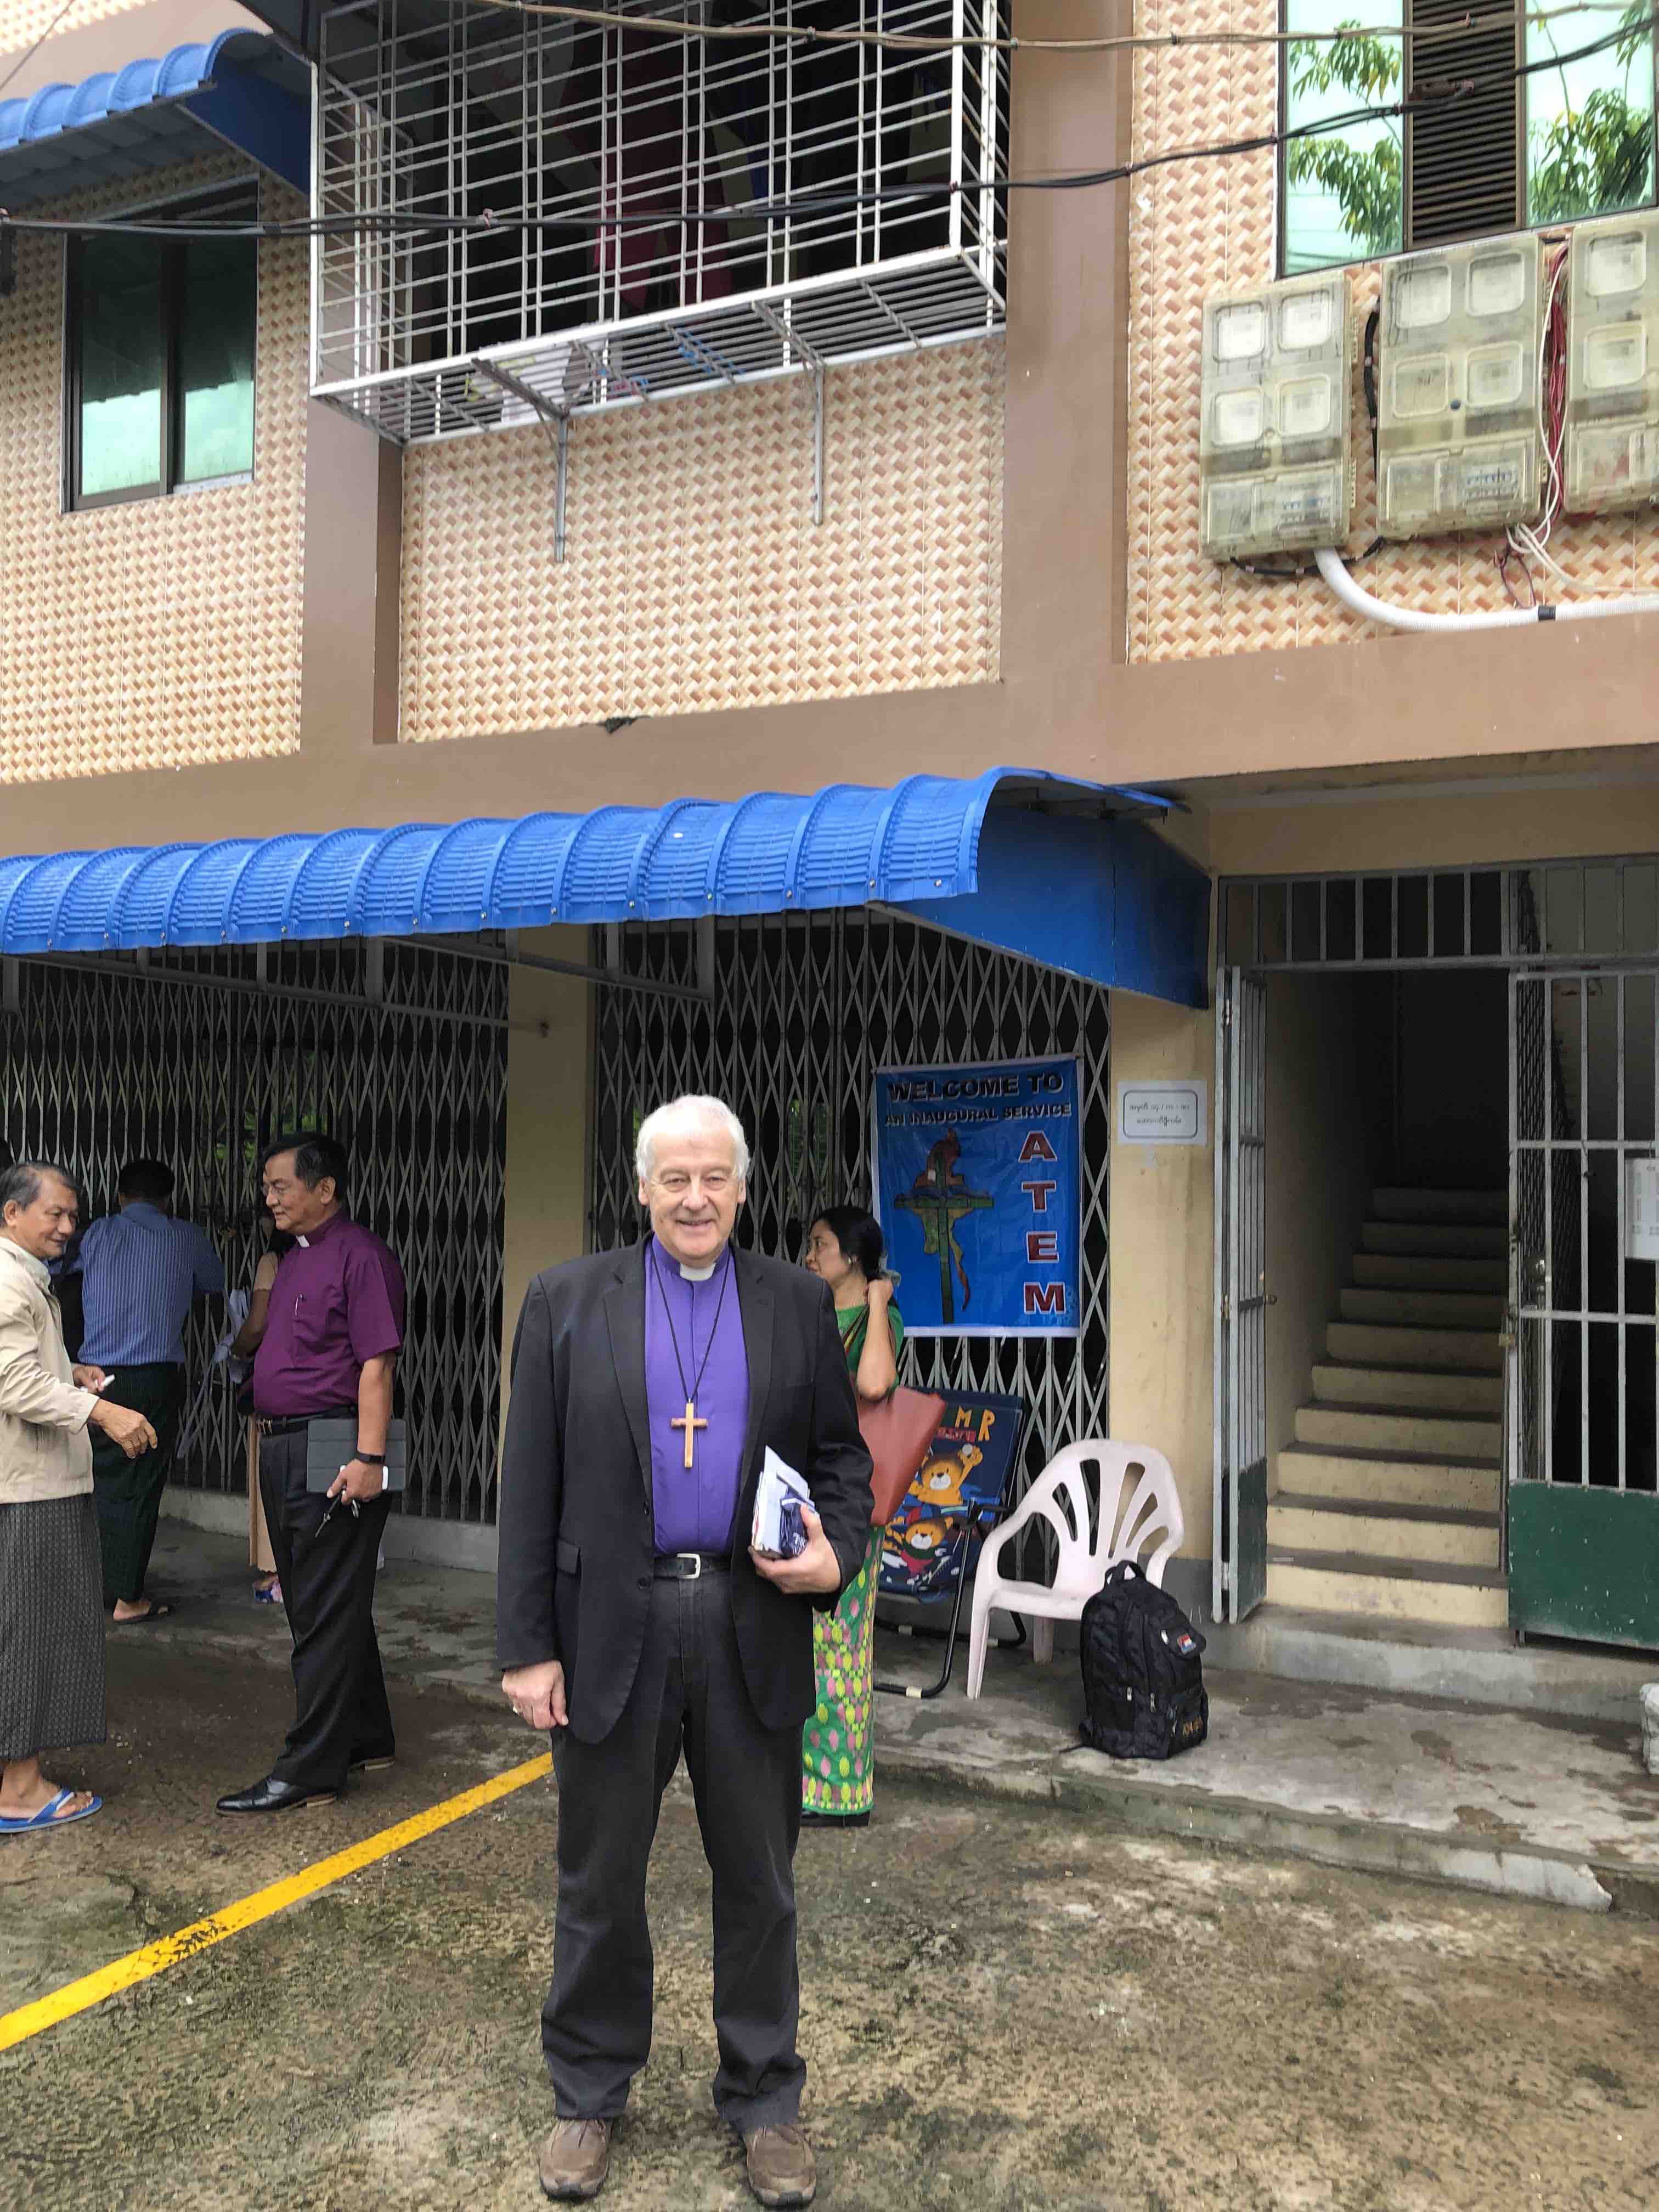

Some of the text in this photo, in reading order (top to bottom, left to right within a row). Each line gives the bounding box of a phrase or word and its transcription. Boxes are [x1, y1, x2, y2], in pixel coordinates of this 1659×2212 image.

[887, 1071, 1064, 1103] WELCOME TO
[885, 1102, 1072, 1127] AN INAUGURAL SERVICE
[1018, 1130, 1066, 1315] ATEM
